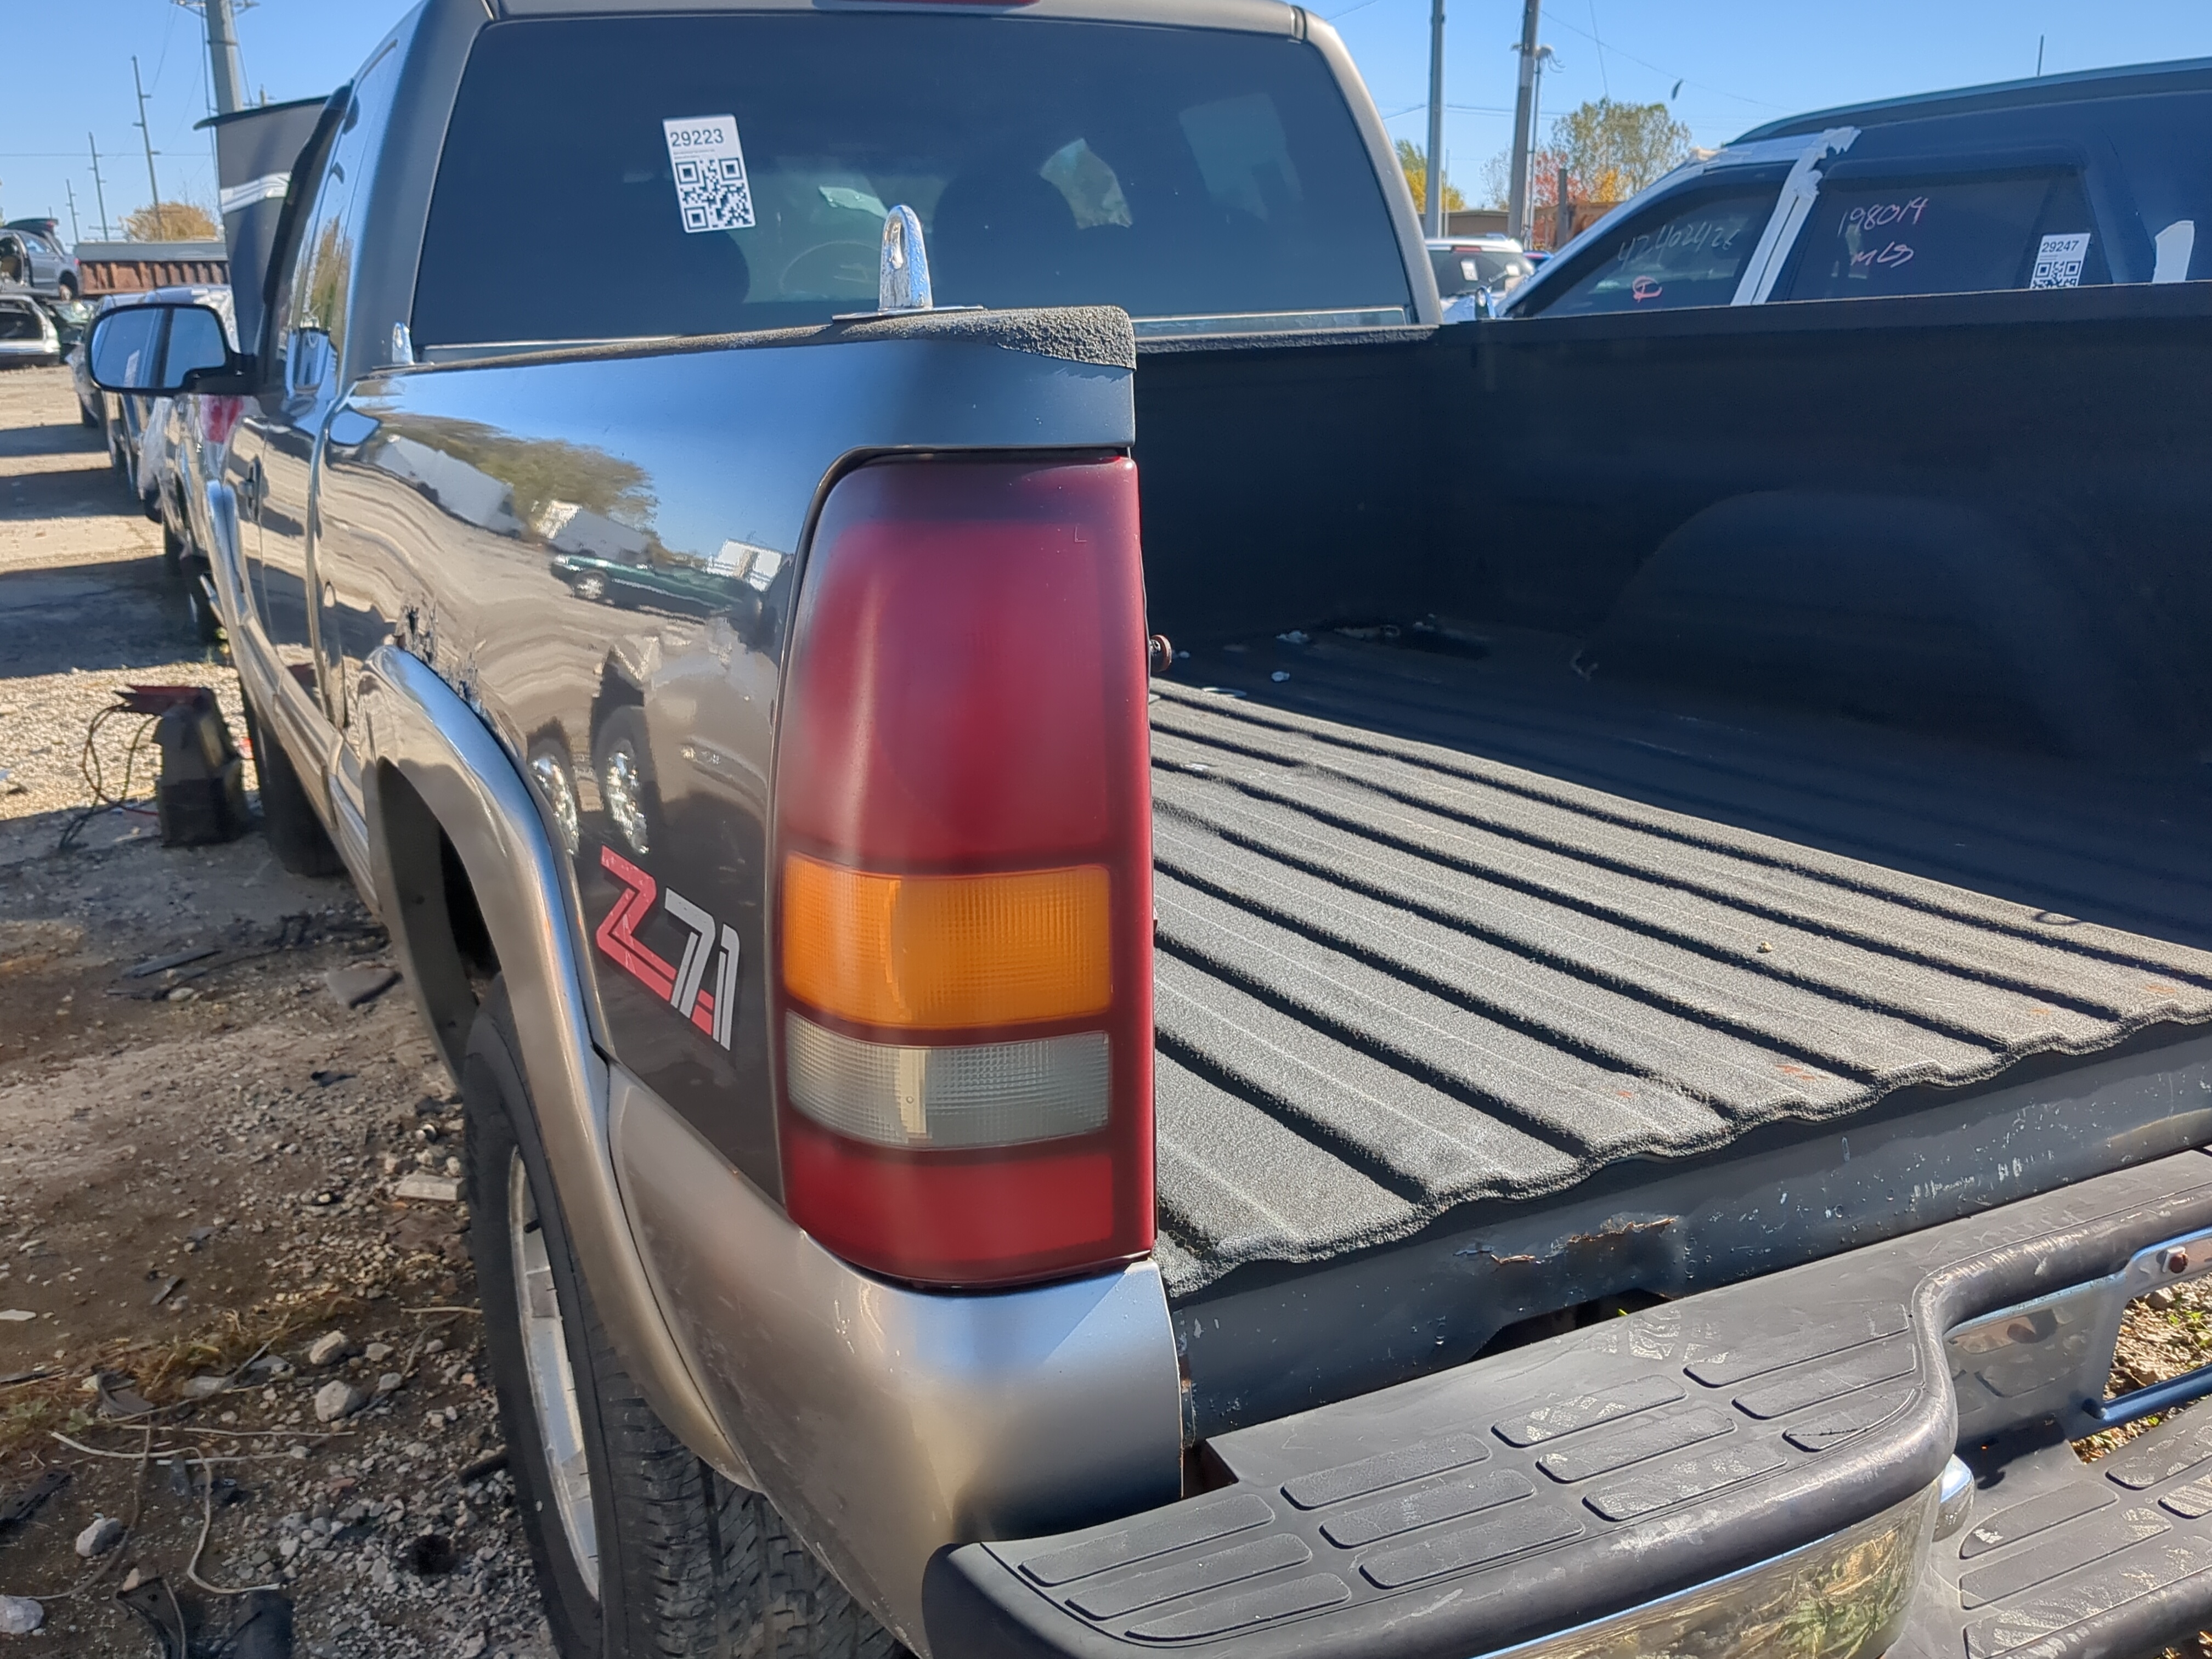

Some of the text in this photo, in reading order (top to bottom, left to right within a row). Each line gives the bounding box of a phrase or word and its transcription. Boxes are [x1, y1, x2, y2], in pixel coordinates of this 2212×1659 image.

[670, 128, 724, 147] 29223
[2041, 240, 2079, 253] 29247
[596, 845, 740, 1051] Z71
